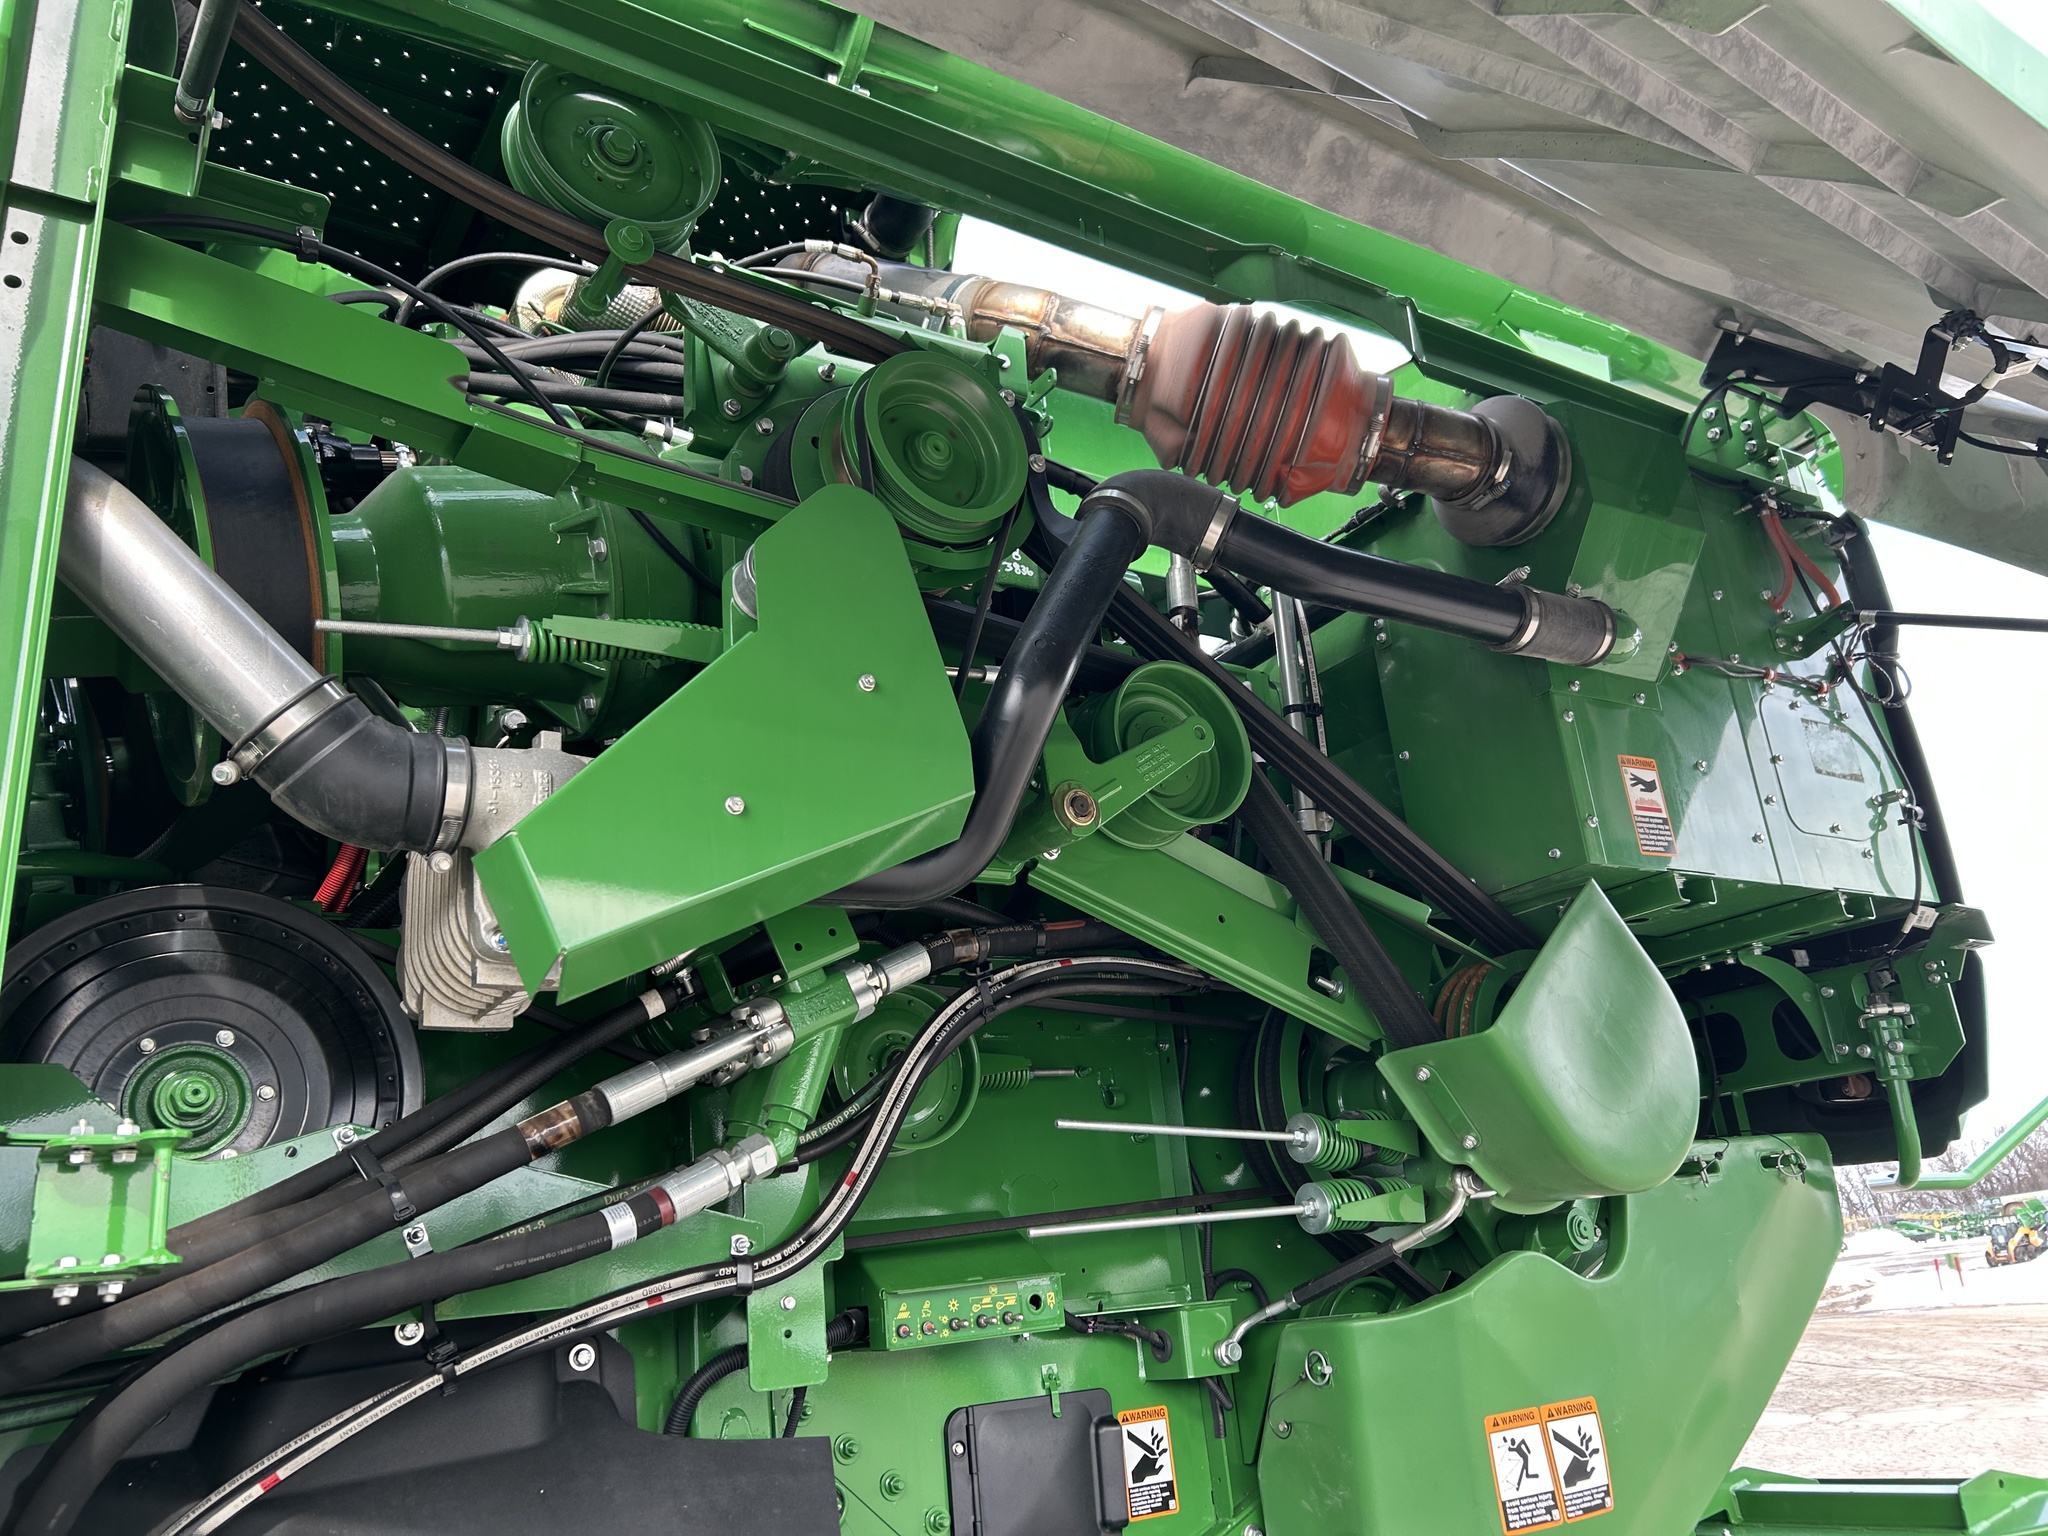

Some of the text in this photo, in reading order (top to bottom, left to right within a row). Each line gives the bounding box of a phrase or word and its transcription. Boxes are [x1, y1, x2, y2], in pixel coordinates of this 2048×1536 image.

[1625, 760, 1655, 769] WARNING
[892, 1066, 909, 1095] ABRASION
[877, 1096, 894, 1128] RESISTANT
[798, 1102, 861, 1144] BAR (5000 PSI)
[819, 1227, 832, 1240] MSHA
[784, 1237, 806, 1256] T3000
[786, 1256, 798, 1267] FRAS
[642, 1283, 672, 1297] T3008D
[592, 1305, 608, 1314] DN12
[534, 1327, 549, 1337] BAR
[550, 1322, 561, 1330] 215
[514, 1336, 529, 1346] 3100
[501, 1344, 513, 1352] PSI
[478, 1349, 499, 1362] MSHA
[380, 1390, 417, 1414] ABRASION
[1555, 1401, 1593, 1416] WARNING
[1129, 1408, 1165, 1421] WARNING
[1501, 1411, 1535, 1426] WARNING
[339, 1412, 379, 1440] RESISTANT
[294, 1434, 310, 1446] MAX
[280, 1444, 293, 1454] WP
[266, 1452, 279, 1462] 215
